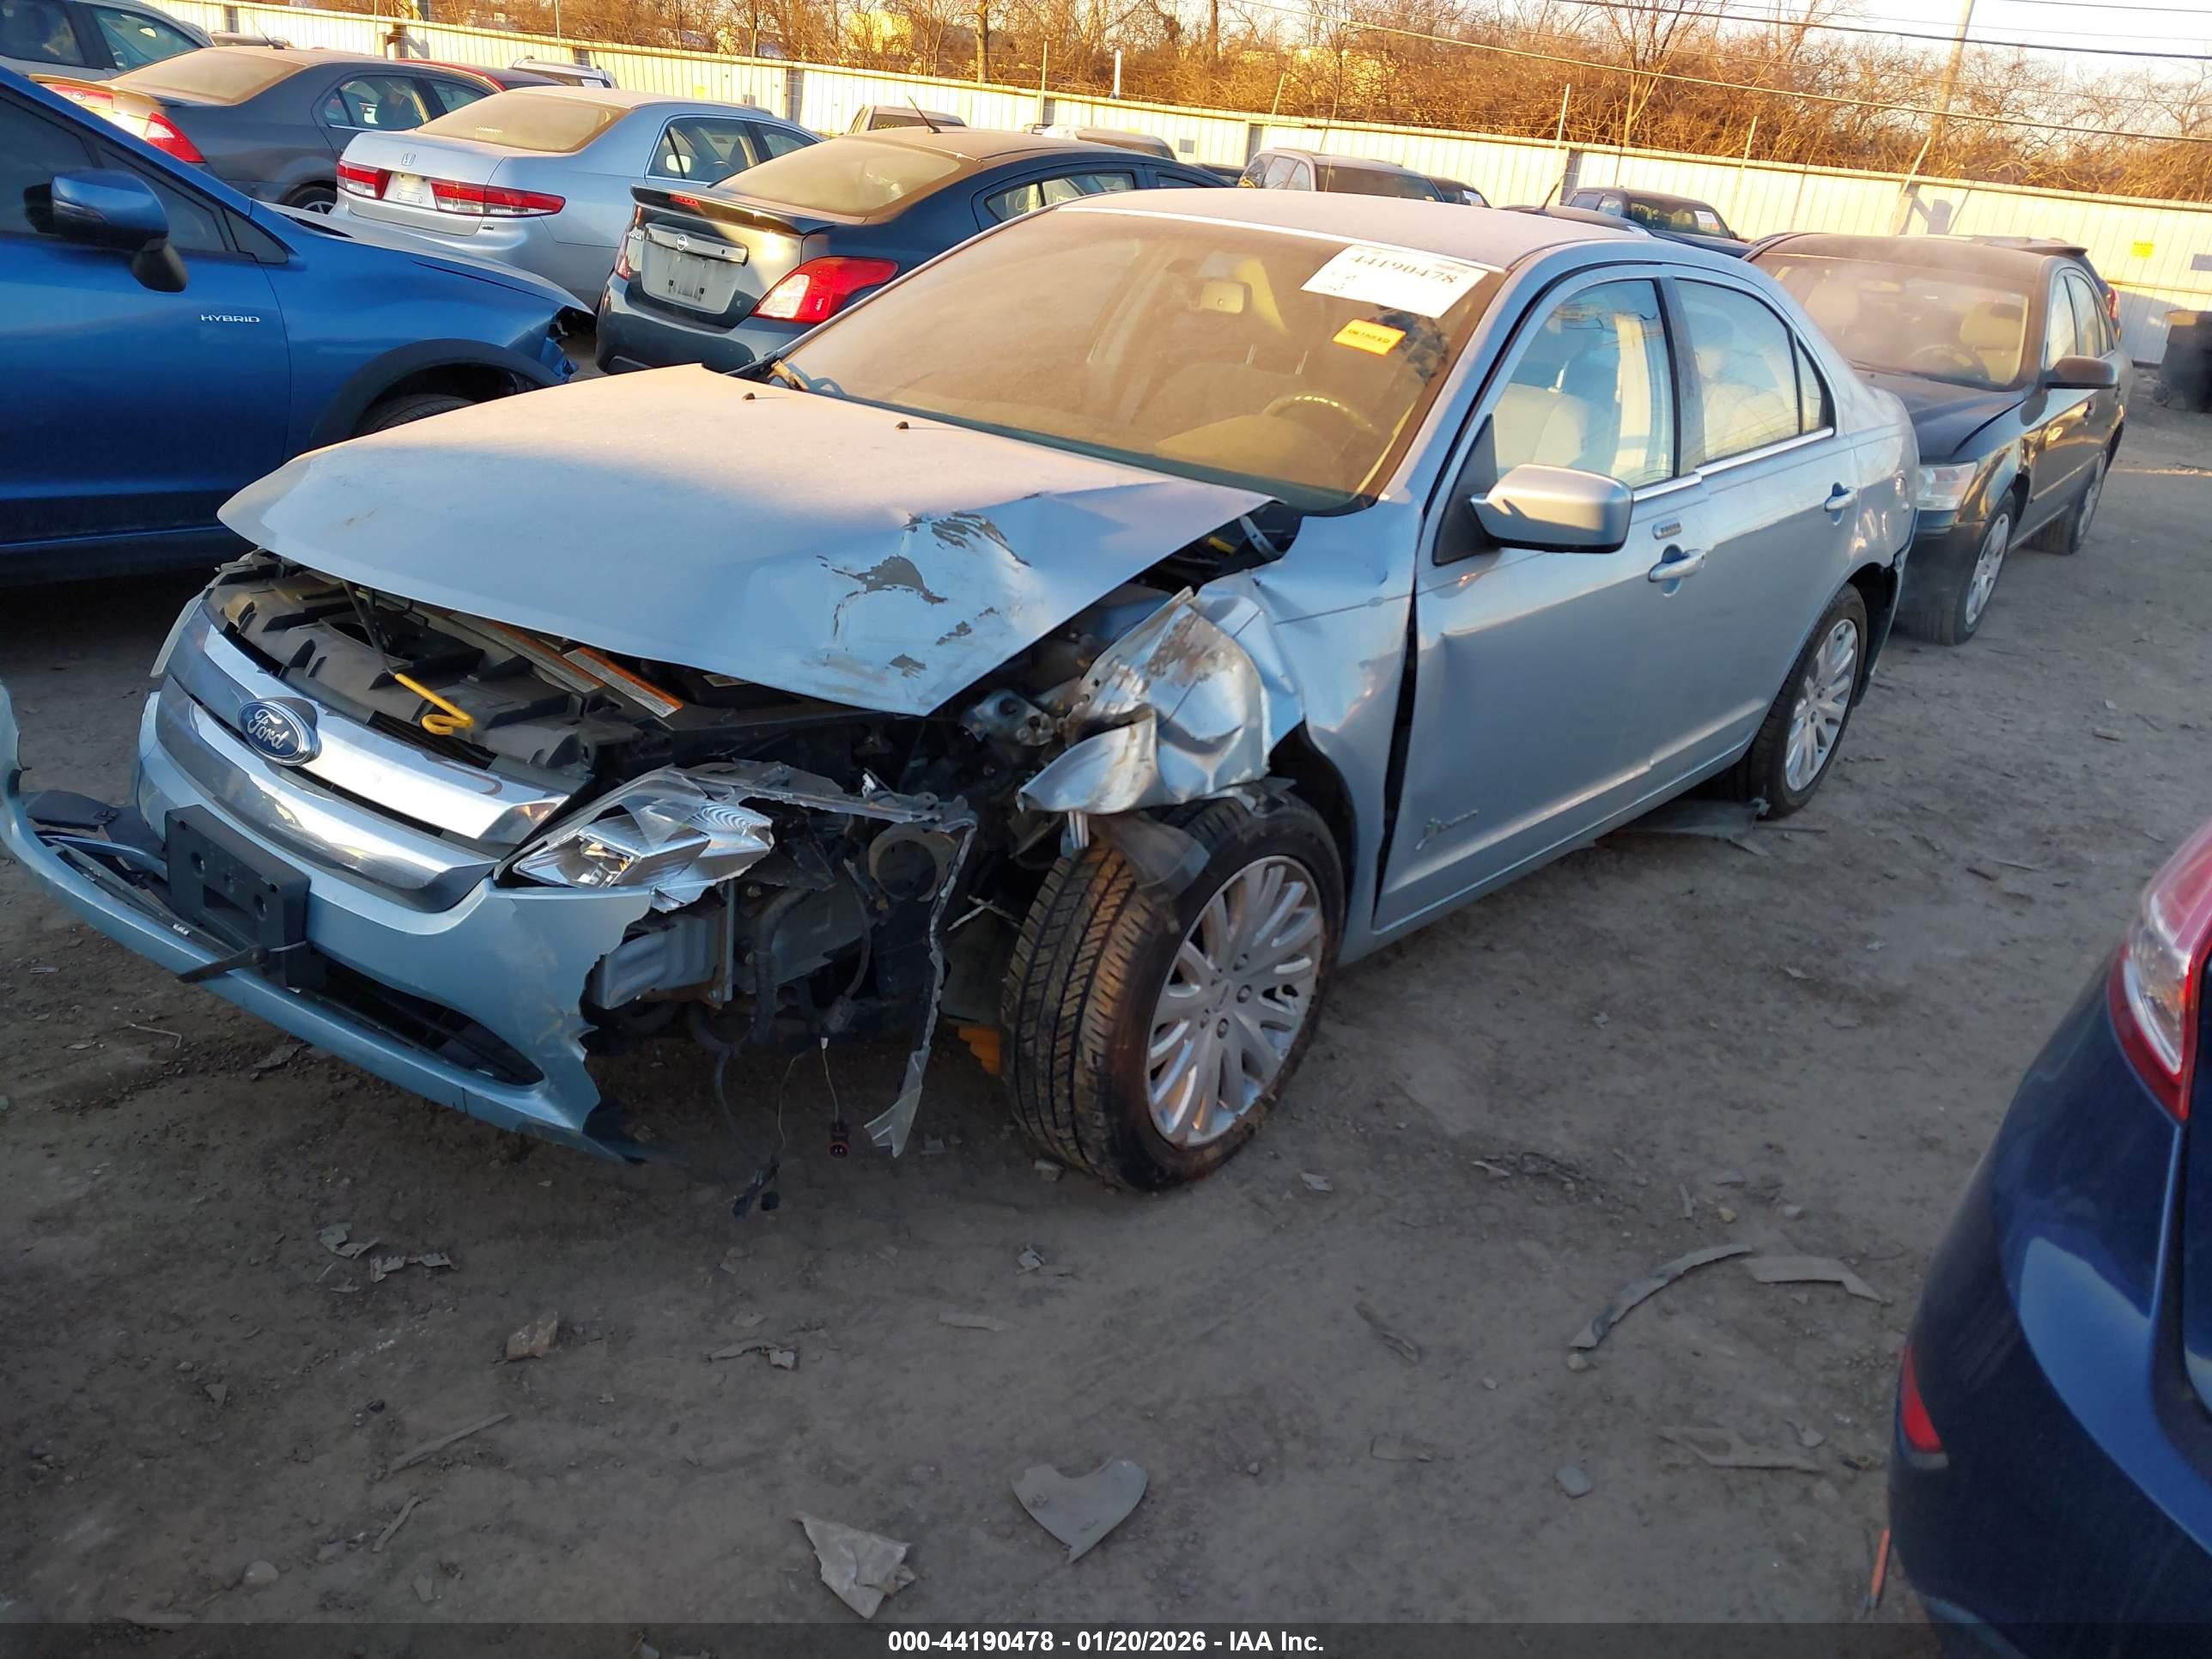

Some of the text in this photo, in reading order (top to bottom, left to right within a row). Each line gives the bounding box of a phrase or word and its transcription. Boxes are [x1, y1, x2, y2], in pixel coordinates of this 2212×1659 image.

[1350, 255, 1458, 283] 44190478
[200, 314, 260, 323] HYBRID
[246, 708, 289, 750] Ford
